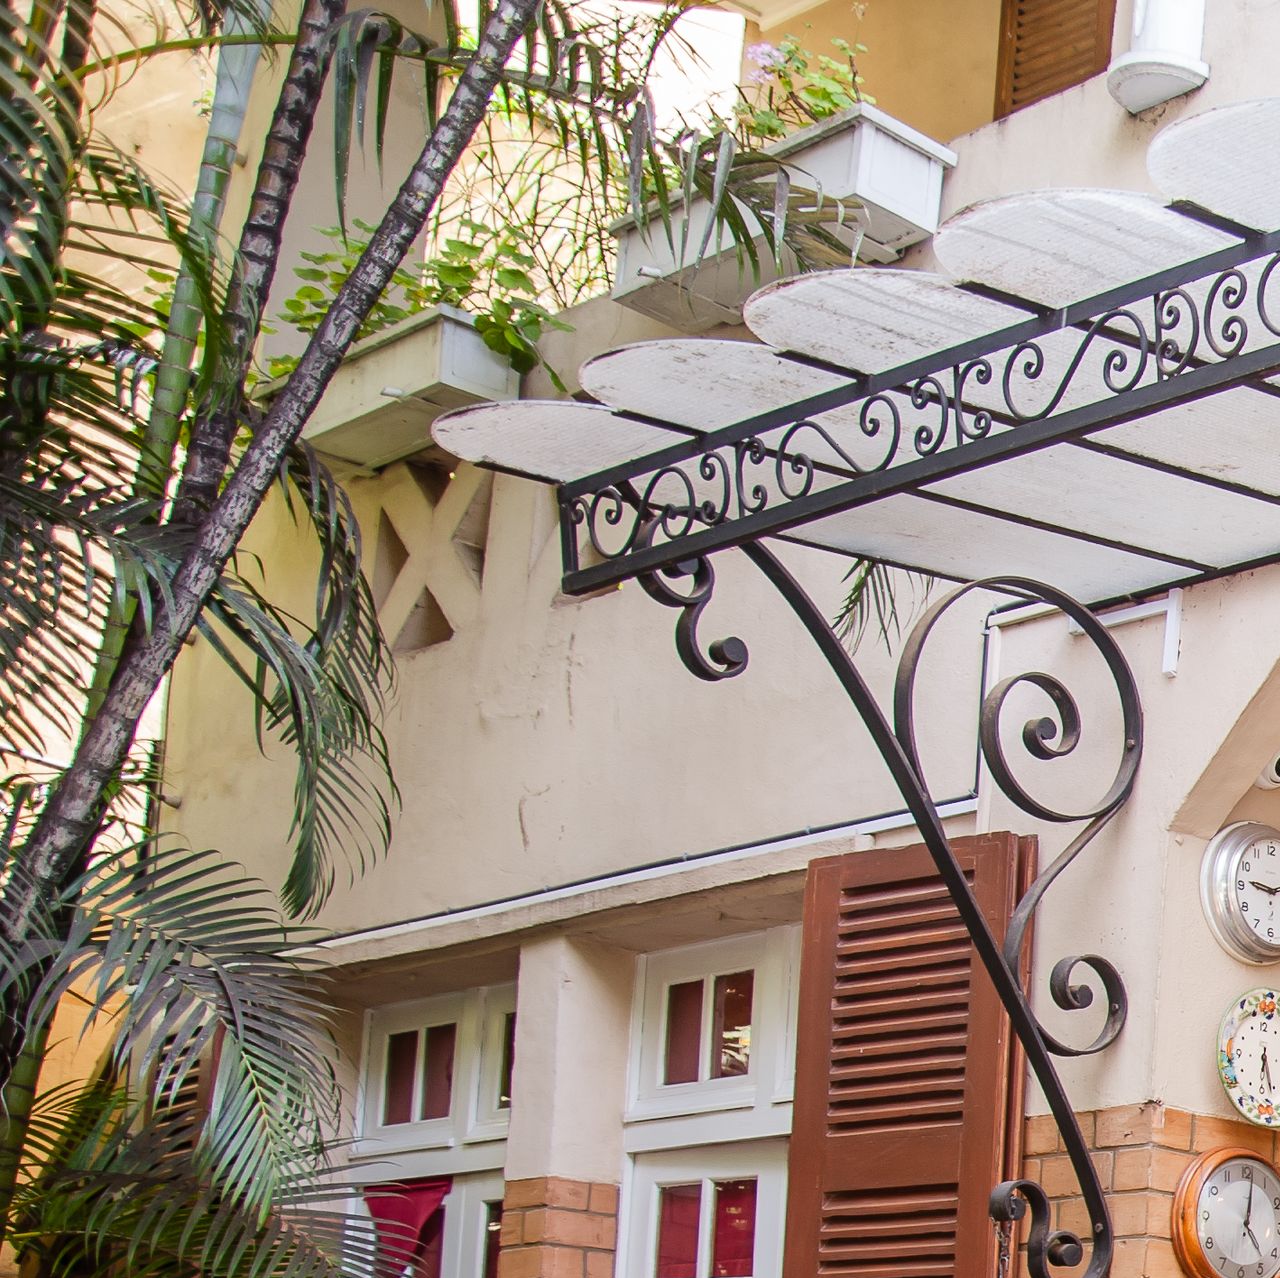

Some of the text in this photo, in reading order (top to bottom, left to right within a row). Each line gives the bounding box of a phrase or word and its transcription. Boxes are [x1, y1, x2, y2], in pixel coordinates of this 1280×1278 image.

[1253, 848, 1260, 859] 11
[1267, 845, 1276, 856] 12
[1241, 861, 1251, 872] 10
[1237, 880, 1245, 890] 9
[1241, 902, 1249, 912] 8
[1253, 919, 1260, 928] 7
[1267, 928, 1274, 937] 6
[1259, 1022, 1268, 1032] 12
[1236, 1049, 1242, 1058] 9
[1259, 1084, 1265, 1094] 6
[1224, 1170, 1231, 1182] 11
[1241, 1166, 1252, 1179] 12
[1273, 1197, 1280, 1210] 2
[1205, 1236, 1214, 1249] 8
[1270, 1247, 1278, 1259] 4
[1219, 1257, 1227, 1269] 7
[1237, 1266, 1245, 1278] 6
[1256, 1263, 1264, 1275] 5
